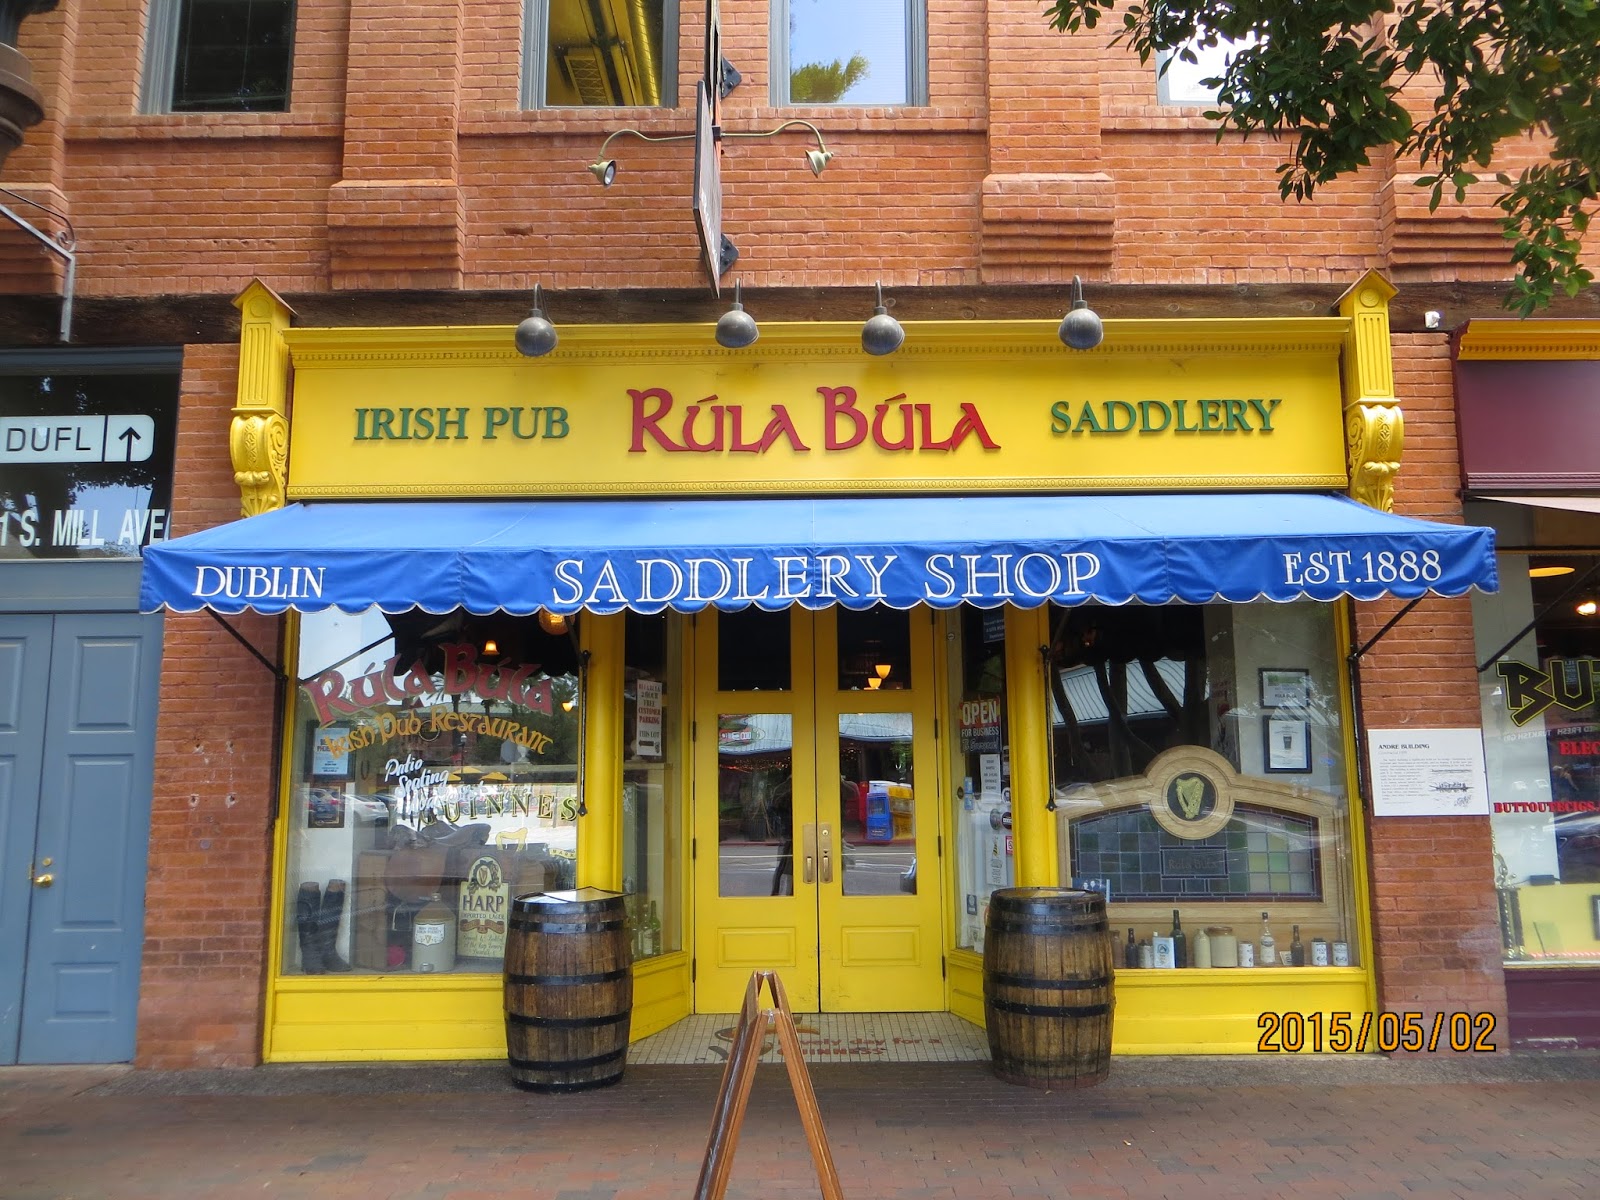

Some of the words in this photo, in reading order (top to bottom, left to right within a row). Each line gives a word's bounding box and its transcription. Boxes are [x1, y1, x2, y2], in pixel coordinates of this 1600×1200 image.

[354, 407, 470, 440] IRISH
[482, 406, 570, 440] PUB
[1050, 399, 1282, 433] SADDLERY
[6, 427, 91, 451] DUFL
[19, 509, 41, 547] S.
[52, 509, 105, 546] MILL
[192, 565, 326, 599] DUBLIN
[552, 554, 898, 604] SADDLERY
[924, 552, 1101, 598] SHOP
[1282, 549, 1442, 586] EST.1888
[1496, 660, 1600, 727] BU
[962, 700, 998, 726] OPEN
[961, 728, 972, 738] FOR
[972, 726, 999, 737] BUSINESS
[462, 895, 505, 914] HARP
[849, 1037, 886, 1046] day
[892, 1037, 921, 1045] for
